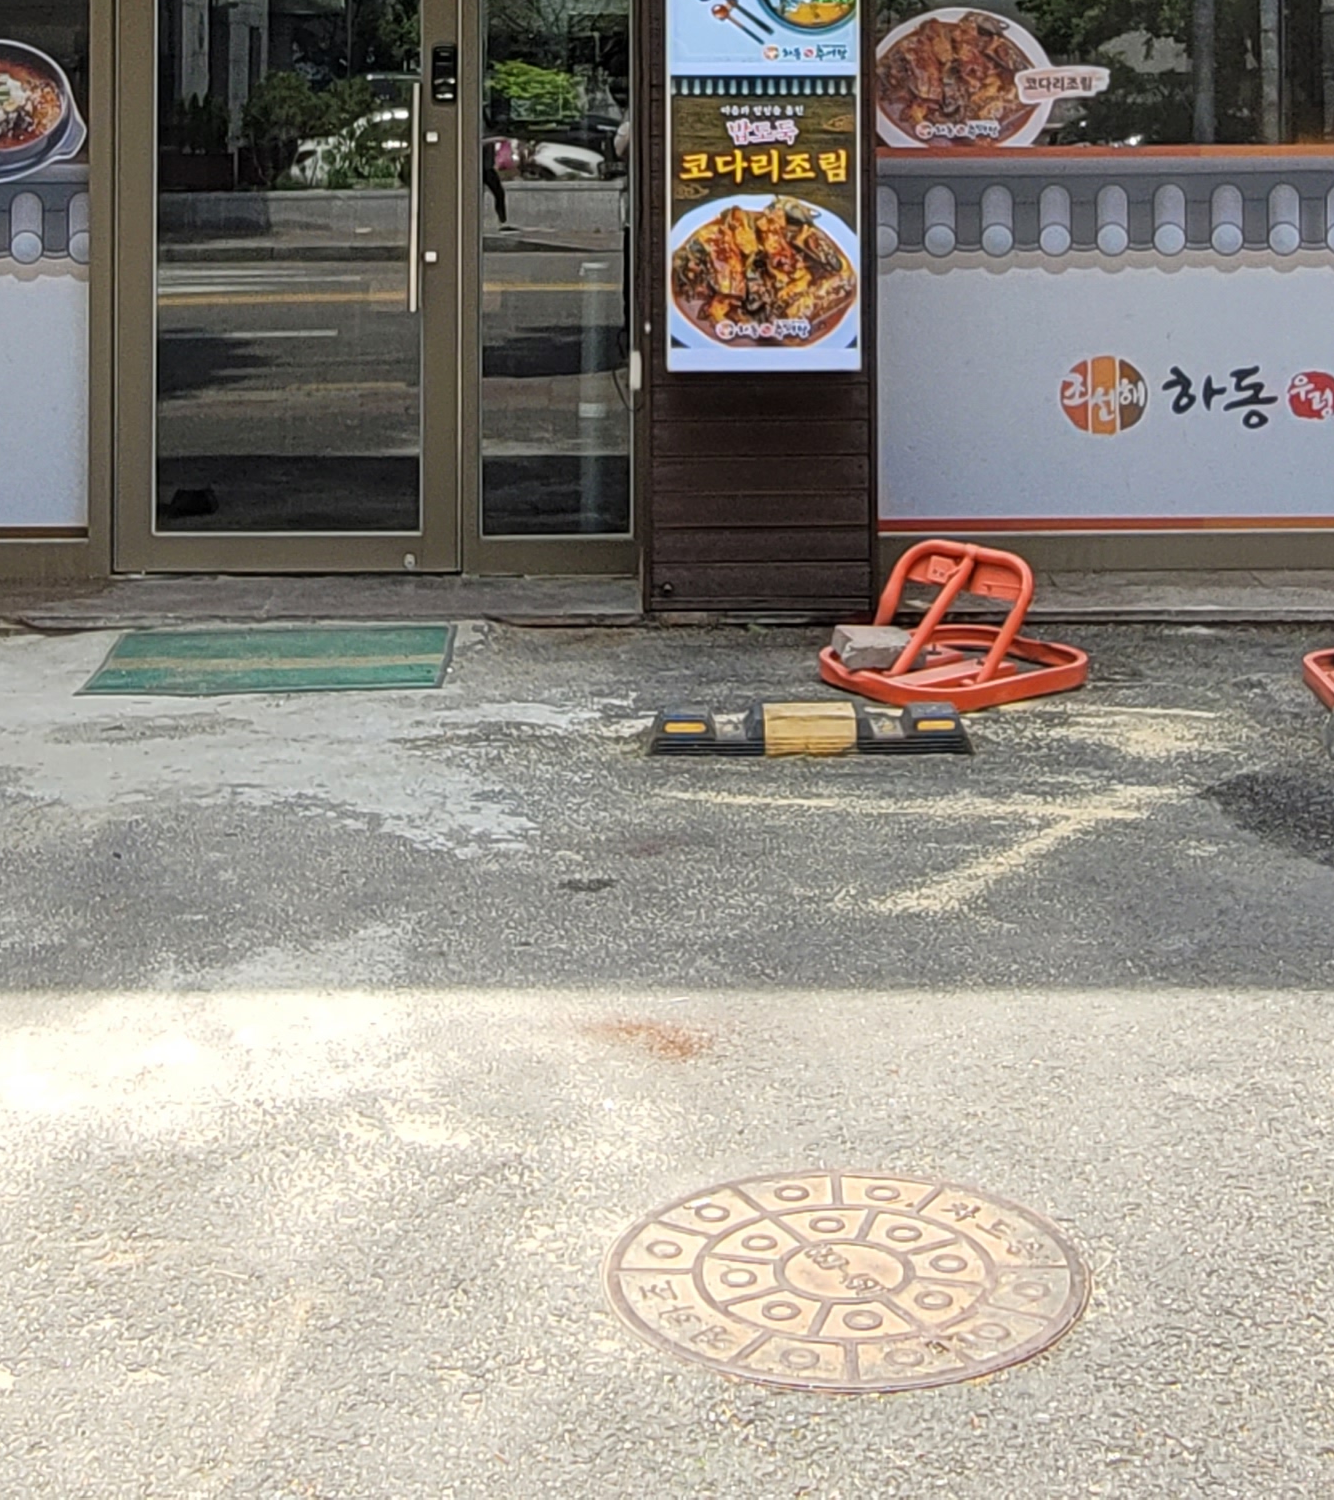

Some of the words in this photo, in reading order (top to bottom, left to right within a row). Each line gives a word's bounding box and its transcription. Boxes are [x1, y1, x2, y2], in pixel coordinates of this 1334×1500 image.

[1024, 76, 1093, 92] 코다리조림
[726, 118, 799, 145] 밥도둑
[679, 149, 848, 184] 코다리조림
[1063, 373, 1146, 423] 조선해
[1161, 365, 1279, 429] 하동
[1288, 375, 1334, 419] 우렁
